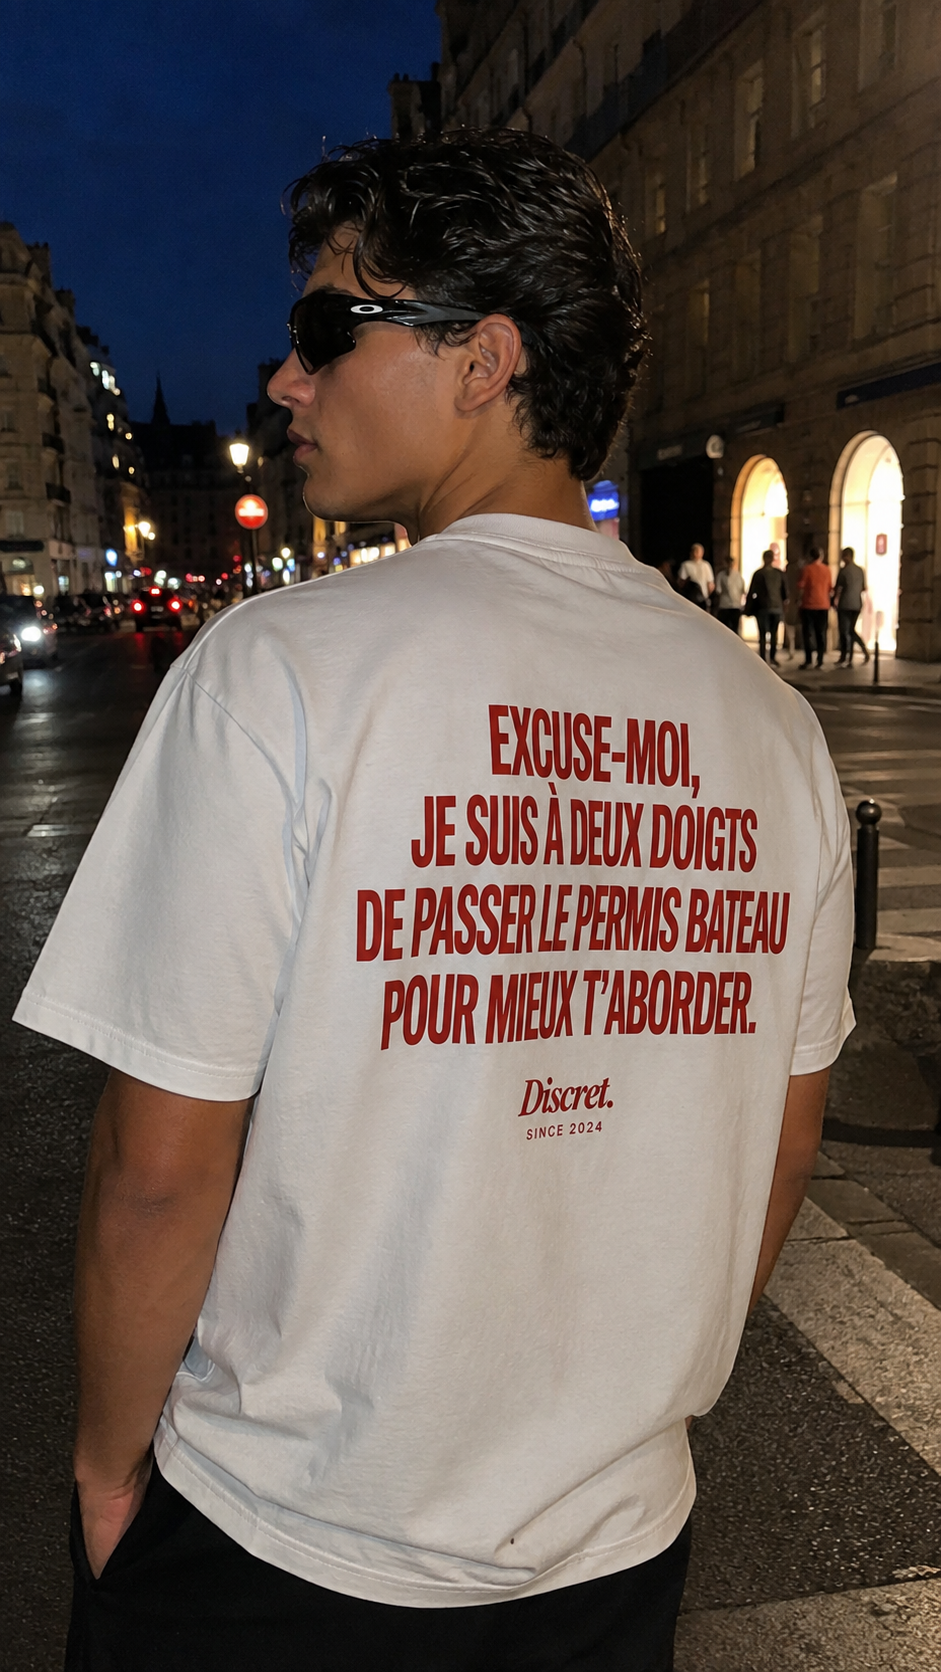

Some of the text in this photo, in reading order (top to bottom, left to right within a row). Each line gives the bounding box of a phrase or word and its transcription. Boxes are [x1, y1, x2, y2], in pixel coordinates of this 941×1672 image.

[488, 704, 700, 799] EXCUSE-MOI,
[411, 781, 758, 873] JE SUIS À DEUX DOIGTS
[356, 884, 791, 962] DE PASSER LE PERMIS BATEAU
[380, 973, 479, 1050] POUR
[485, 970, 578, 1044] MIEUX
[518, 1077, 614, 1117] Discret.
[526, 1121, 603, 1140] SINCE 2024
